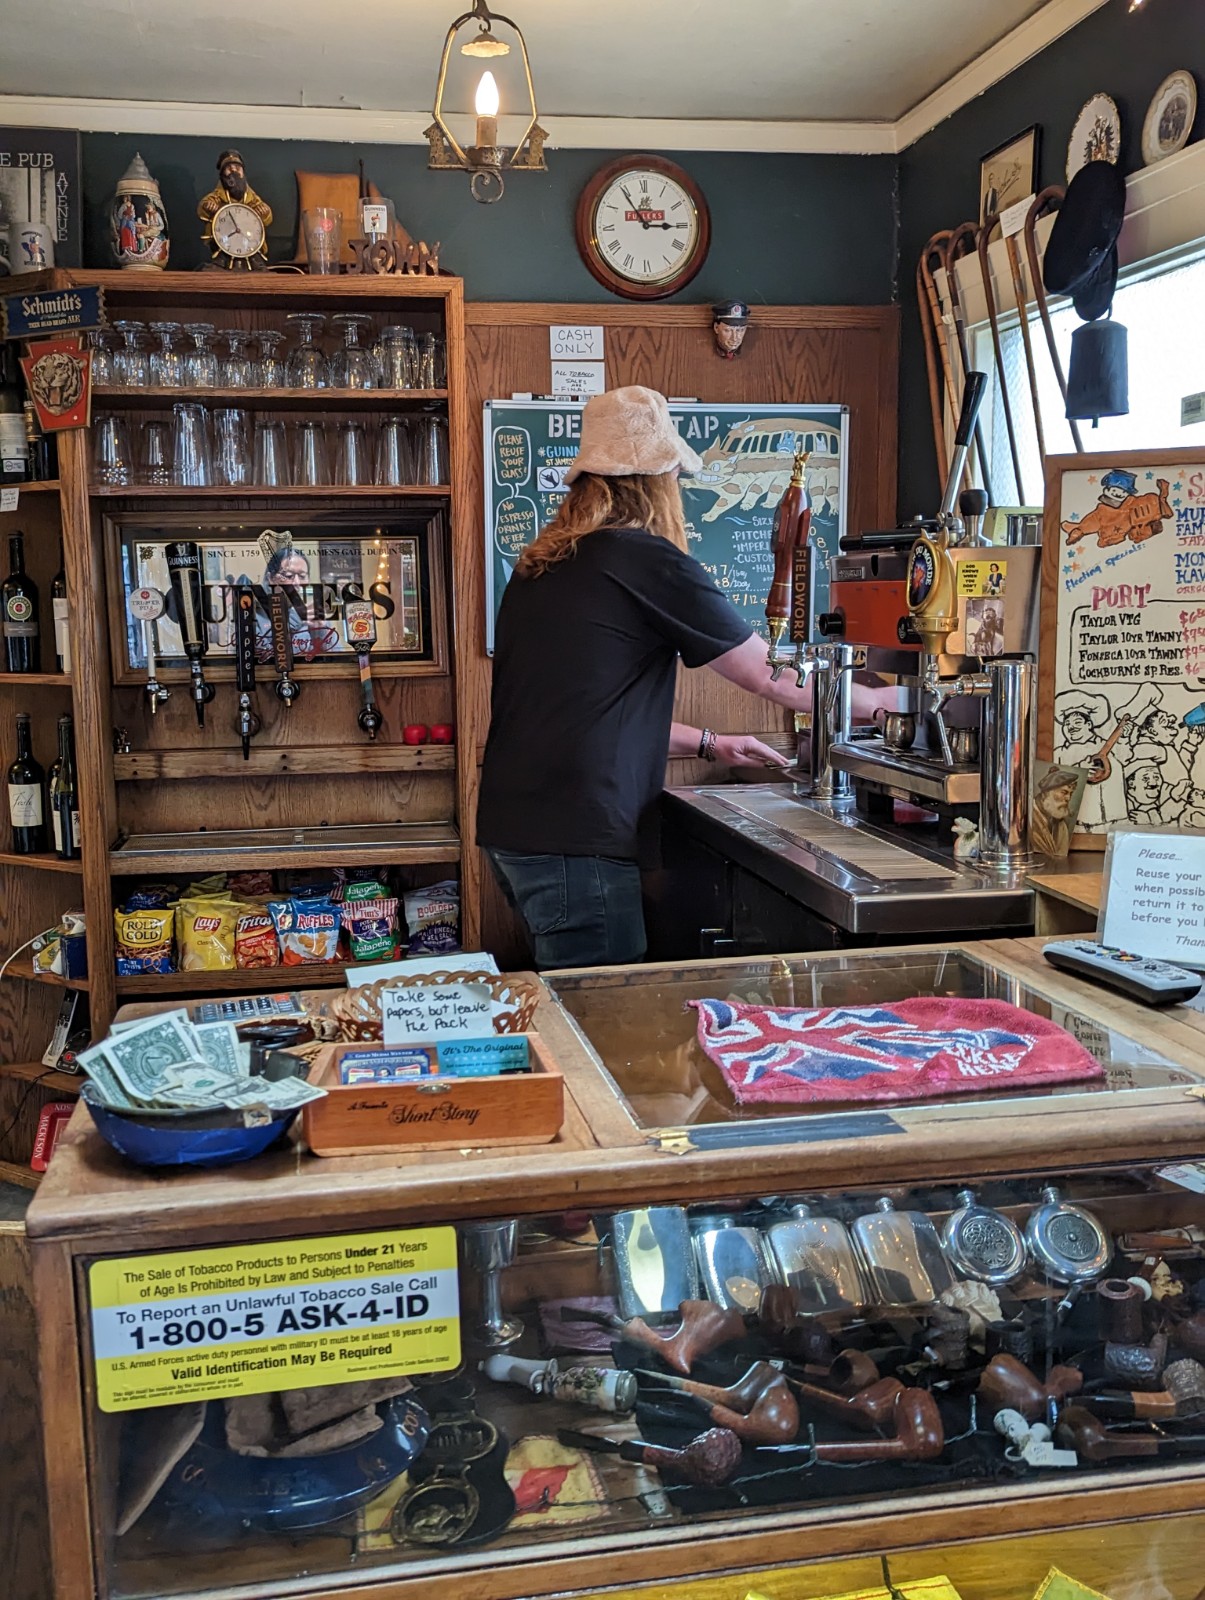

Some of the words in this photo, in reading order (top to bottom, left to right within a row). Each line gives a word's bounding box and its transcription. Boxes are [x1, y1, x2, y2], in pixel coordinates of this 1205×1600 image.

[18, 152, 54, 168] PUB
[56, 172, 69, 241] AVENUE
[22, 292, 82, 317] Schmidt's
[558, 329, 592, 341] CASH
[554, 342, 594, 354] ONLY
[548, 413, 581, 439] BE
[497, 434, 524, 446] PLEASE
[499, 447, 525, 457] REUSE
[546, 446, 580, 458] GUINN
[500, 457, 524, 469] YOUR
[499, 510, 535, 524] ESPRESSO
[752, 516, 774, 527] SIZE
[497, 521, 532, 534] DRINKS
[501, 532, 527, 545] AFTER
[734, 530, 773, 541] PITCHE
[168, 555, 198, 566] GUINNESS
[207, 550, 236, 558] SINCE
[240, 550, 260, 558] 1759
[922, 548, 934, 586] MONDE
[1065, 565, 1102, 593] fleeting
[1105, 543, 1146, 566] specials:
[793, 549, 807, 640] FIELDWORK
[1091, 583, 1151, 611] PORT
[355, 621, 368, 633] 5
[1079, 614, 1117, 628] TAYLOR
[1119, 612, 1141, 625] VTG
[271, 595, 288, 670] FIELDWORK
[1079, 632, 1119, 645] TAYLOR
[1121, 631, 1143, 643] 10YR
[1146, 630, 1182, 643] TAWNY
[1079, 648, 1125, 662] FONSECA
[1148, 646, 1185, 660] TAWNY
[1079, 663, 1141, 680] COCKBURN'S
[1136, 867, 1170, 879] Reuse
[1175, 870, 1202, 882] your
[1134, 883, 1163, 894] when
[1168, 886, 1205, 897] possib
[1132, 898, 1171, 909] return
[1176, 900, 1186, 911] it
[1191, 901, 1204, 912] to
[359, 908, 380, 918] Tim's
[1131, 912, 1172, 924] before
[1177, 917, 1198, 928] you
[127, 920, 158, 931] ROLD
[193, 917, 221, 931] Lay's
[237, 914, 273, 933] Fritos
[297, 914, 335, 929] RUFFLES
[126, 930, 158, 940] GOLD
[1175, 935, 1205, 948] Than
[386, 990, 425, 1003] Take
[428, 1004, 450, 1016] but
[406, 1020, 429, 1032] the
[442, 1043, 462, 1055] It's
[463, 1043, 482, 1054] The
[484, 1042, 525, 1055] Original
[389, 1104, 436, 1126] Short
[436, 1101, 481, 1126] Story
[34, 1114, 50, 1159] MACKESON
[123, 1272, 145, 1284] The
[147, 1268, 172, 1281] Sale
[175, 1266, 186, 1278] of
[188, 1262, 233, 1276] Tobacco
[236, 1256, 283, 1271] Products
[286, 1254, 297, 1265] to
[300, 1250, 342, 1264] Persons
[345, 1246, 379, 1259] Under
[382, 1244, 395, 1254] 21
[399, 1241, 428, 1252] Years
[140, 1287, 152, 1298] of
[153, 1284, 175, 1297] Age
[178, 1283, 187, 1293] Is
[190, 1275, 245, 1292] Prohibited
[248, 1274, 261, 1287] by
[264, 1272, 286, 1285] Law
[289, 1269, 309, 1281] and
[312, 1265, 352, 1280] Subject
[354, 1263, 365, 1273] to
[368, 1258, 415, 1272] Penalties
[116, 1310, 136, 1325] To
[141, 1304, 197, 1322] Report
[202, 1303, 221, 1315] an
[226, 1292, 295, 1312] Unlawful
[299, 1286, 366, 1303] Tobacco
[371, 1281, 404, 1296] Sale
[408, 1276, 438, 1292] Call
[130, 1312, 265, 1350] 1-800-5
[276, 1293, 430, 1333] ASK-4-ID
[111, 1362, 128, 1372] U.S.
[130, 1358, 156, 1369] Armed
[158, 1356, 184, 1367] Forces
[186, 1353, 210, 1363] active
[212, 1350, 229, 1361] duty
[230, 1345, 269, 1358] personnel
[271, 1342, 287, 1351] with
[289, 1338, 317, 1350] military
[319, 1337, 327, 1346] ID
[330, 1335, 348, 1345] must
[350, 1333, 360, 1342] be
[362, 1332, 370, 1341] at
[371, 1330, 390, 1340] least
[402, 1327, 423, 1337] years
[424, 1325, 432, 1334] of
[433, 1324, 448, 1335] age
[171, 1366, 202, 1381] Valid
[206, 1356, 287, 1376] Identification
[291, 1353, 316, 1366] May
[320, 1351, 335, 1362] Be
[339, 1343, 392, 1360] Required
